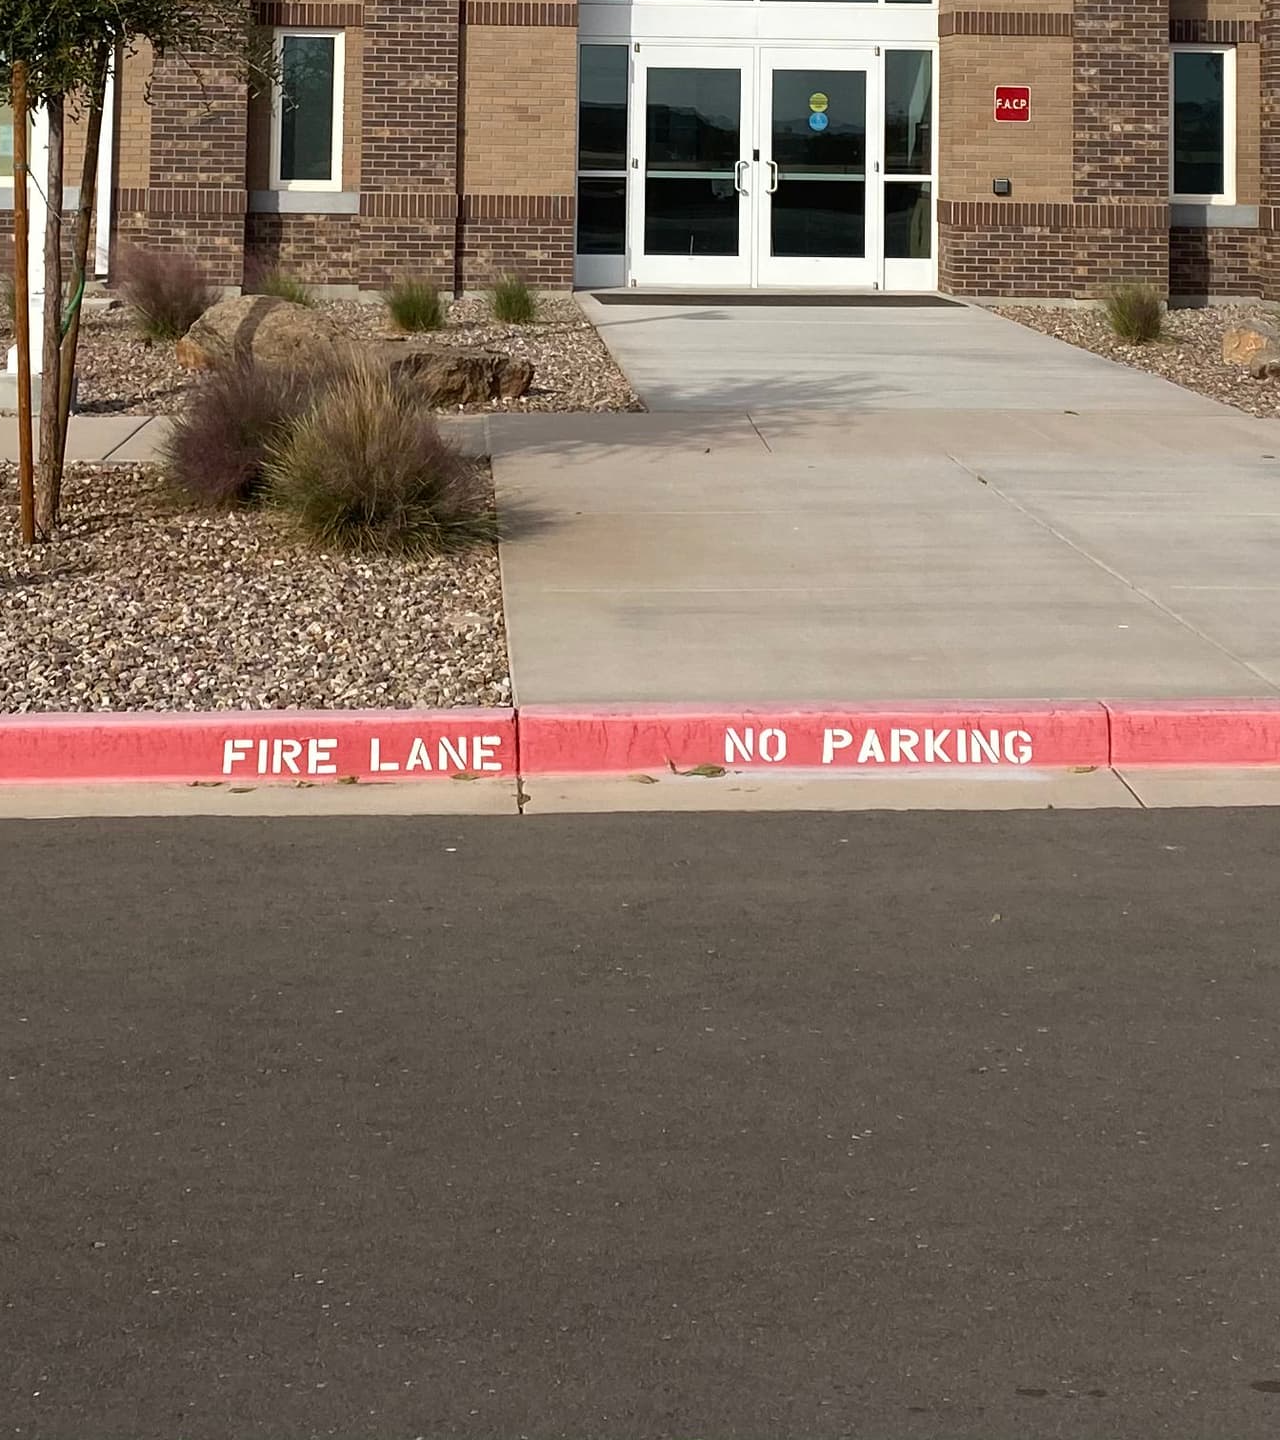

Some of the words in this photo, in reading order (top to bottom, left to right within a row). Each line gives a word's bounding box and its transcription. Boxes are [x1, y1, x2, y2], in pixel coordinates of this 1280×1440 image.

[222, 738, 338, 774] FIRE
[370, 735, 502, 772] LANE
[724, 728, 787, 763] NO
[822, 728, 1033, 764] PARKING
